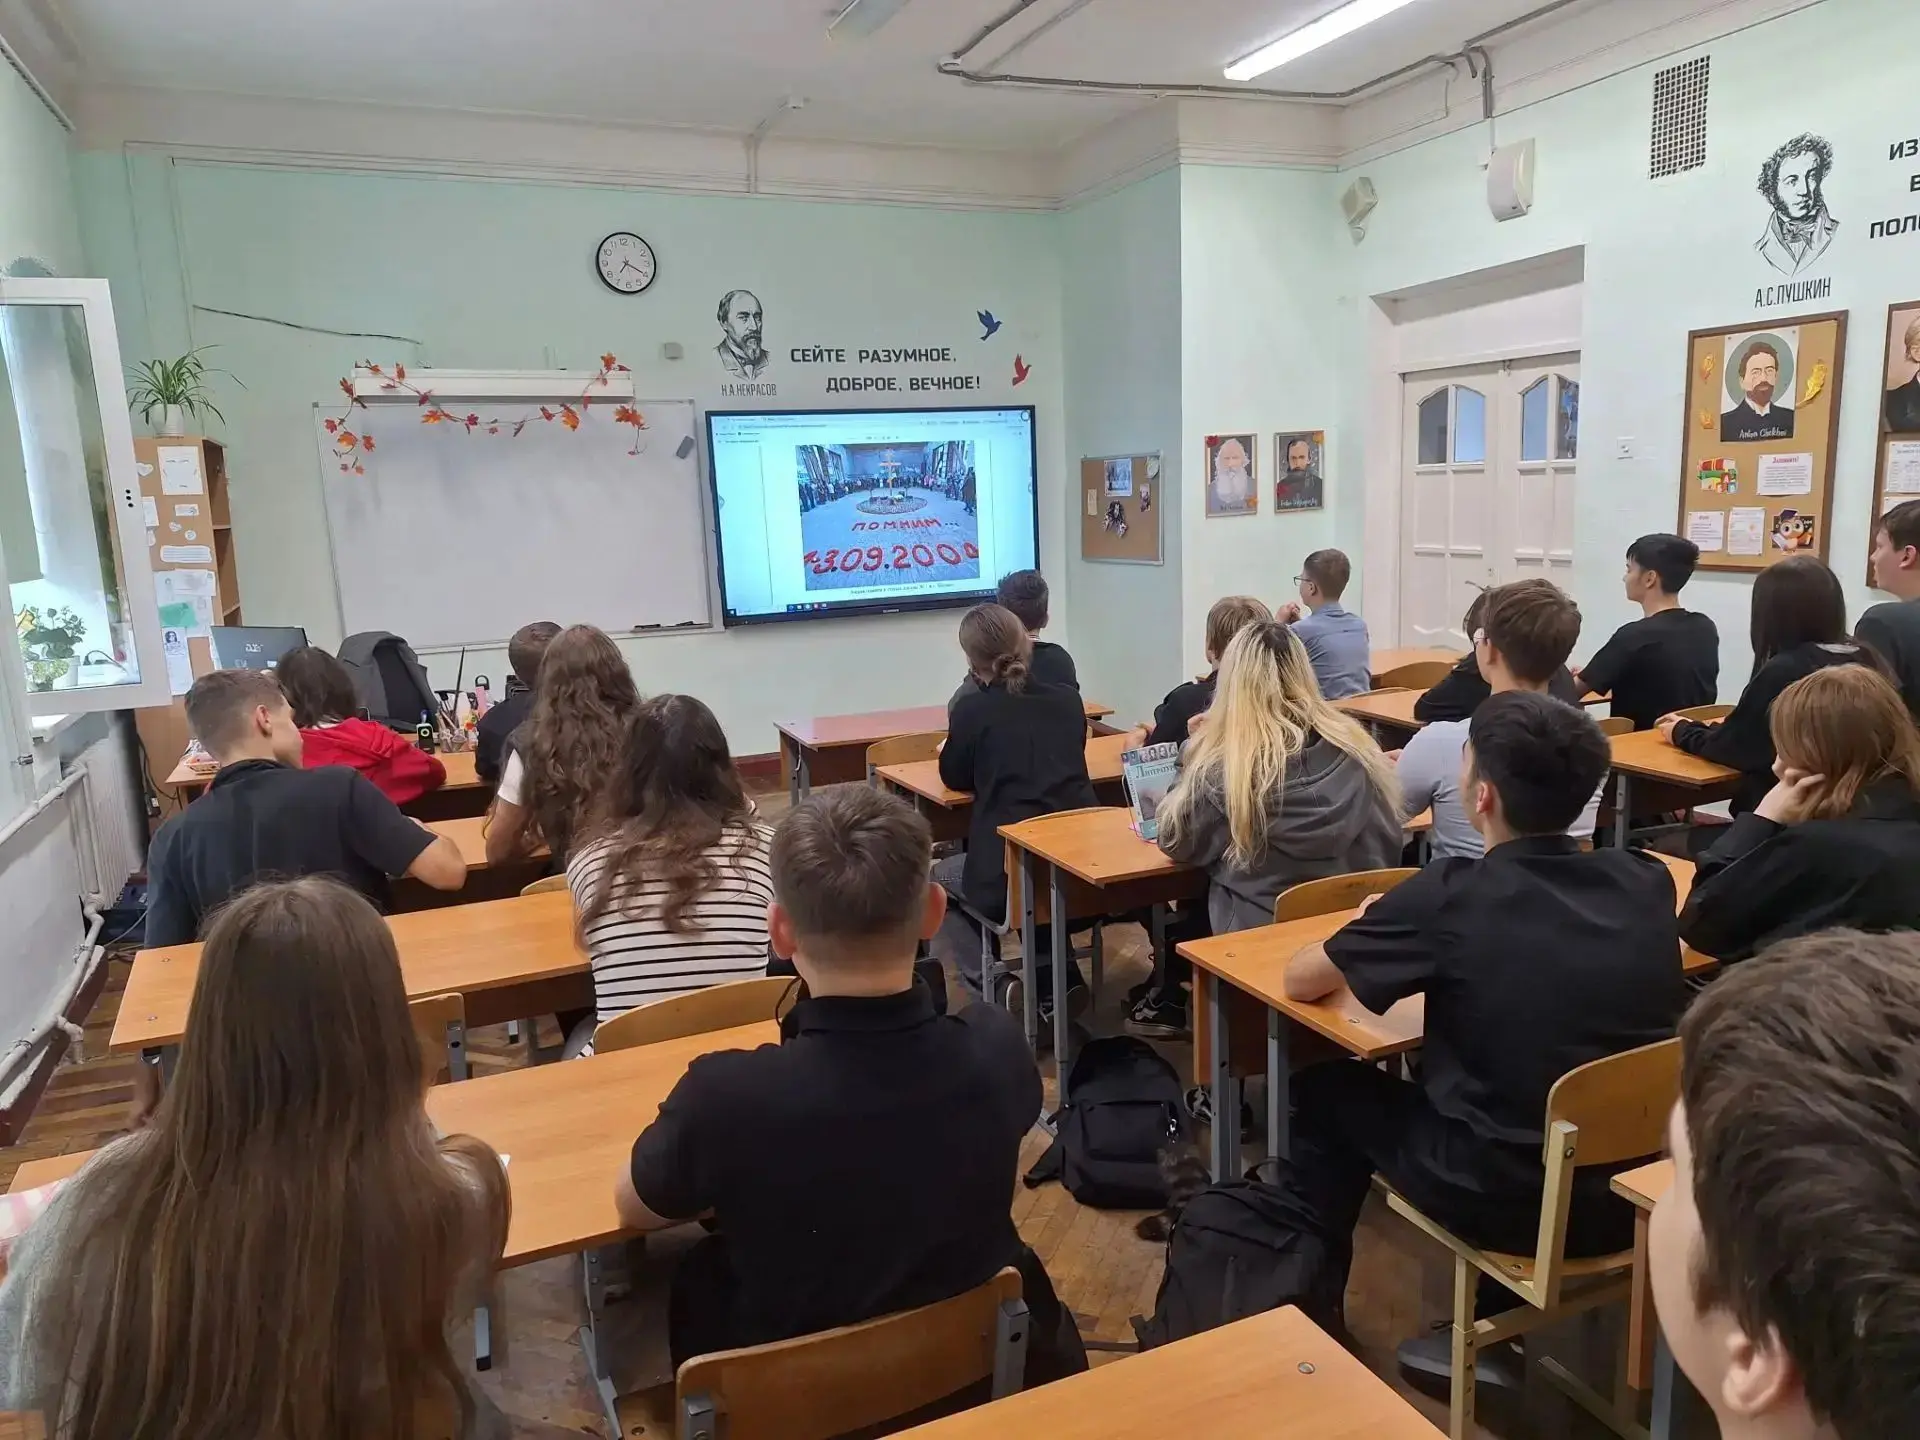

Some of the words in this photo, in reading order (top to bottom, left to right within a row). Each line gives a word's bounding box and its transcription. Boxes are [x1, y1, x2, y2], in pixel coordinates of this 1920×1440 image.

[1889, 138, 1920, 161] ИЗ
[1869, 214, 1920, 239] ПОЛ
[610, 240, 617, 249] 11
[619, 238, 628, 246] 12
[603, 248, 612, 256] 10
[640, 249, 646, 257] 2
[601, 259, 608, 267] 9
[606, 270, 613, 278] 8
[625, 281, 632, 289] 6
[1754, 277, 1831, 309] А.С.ПУШКИН
[790, 345, 846, 363] СЕЙТЕ
[858, 347, 957, 364] РАЗУМНОЕ,
[825, 377, 902, 393] ДОБРОЕ,
[910, 375, 981, 392] ВЕЧНОЕ!
[721, 383, 777, 397] Н.А.НЕКРАСОВ
[1739, 428, 1758, 440] Anton
